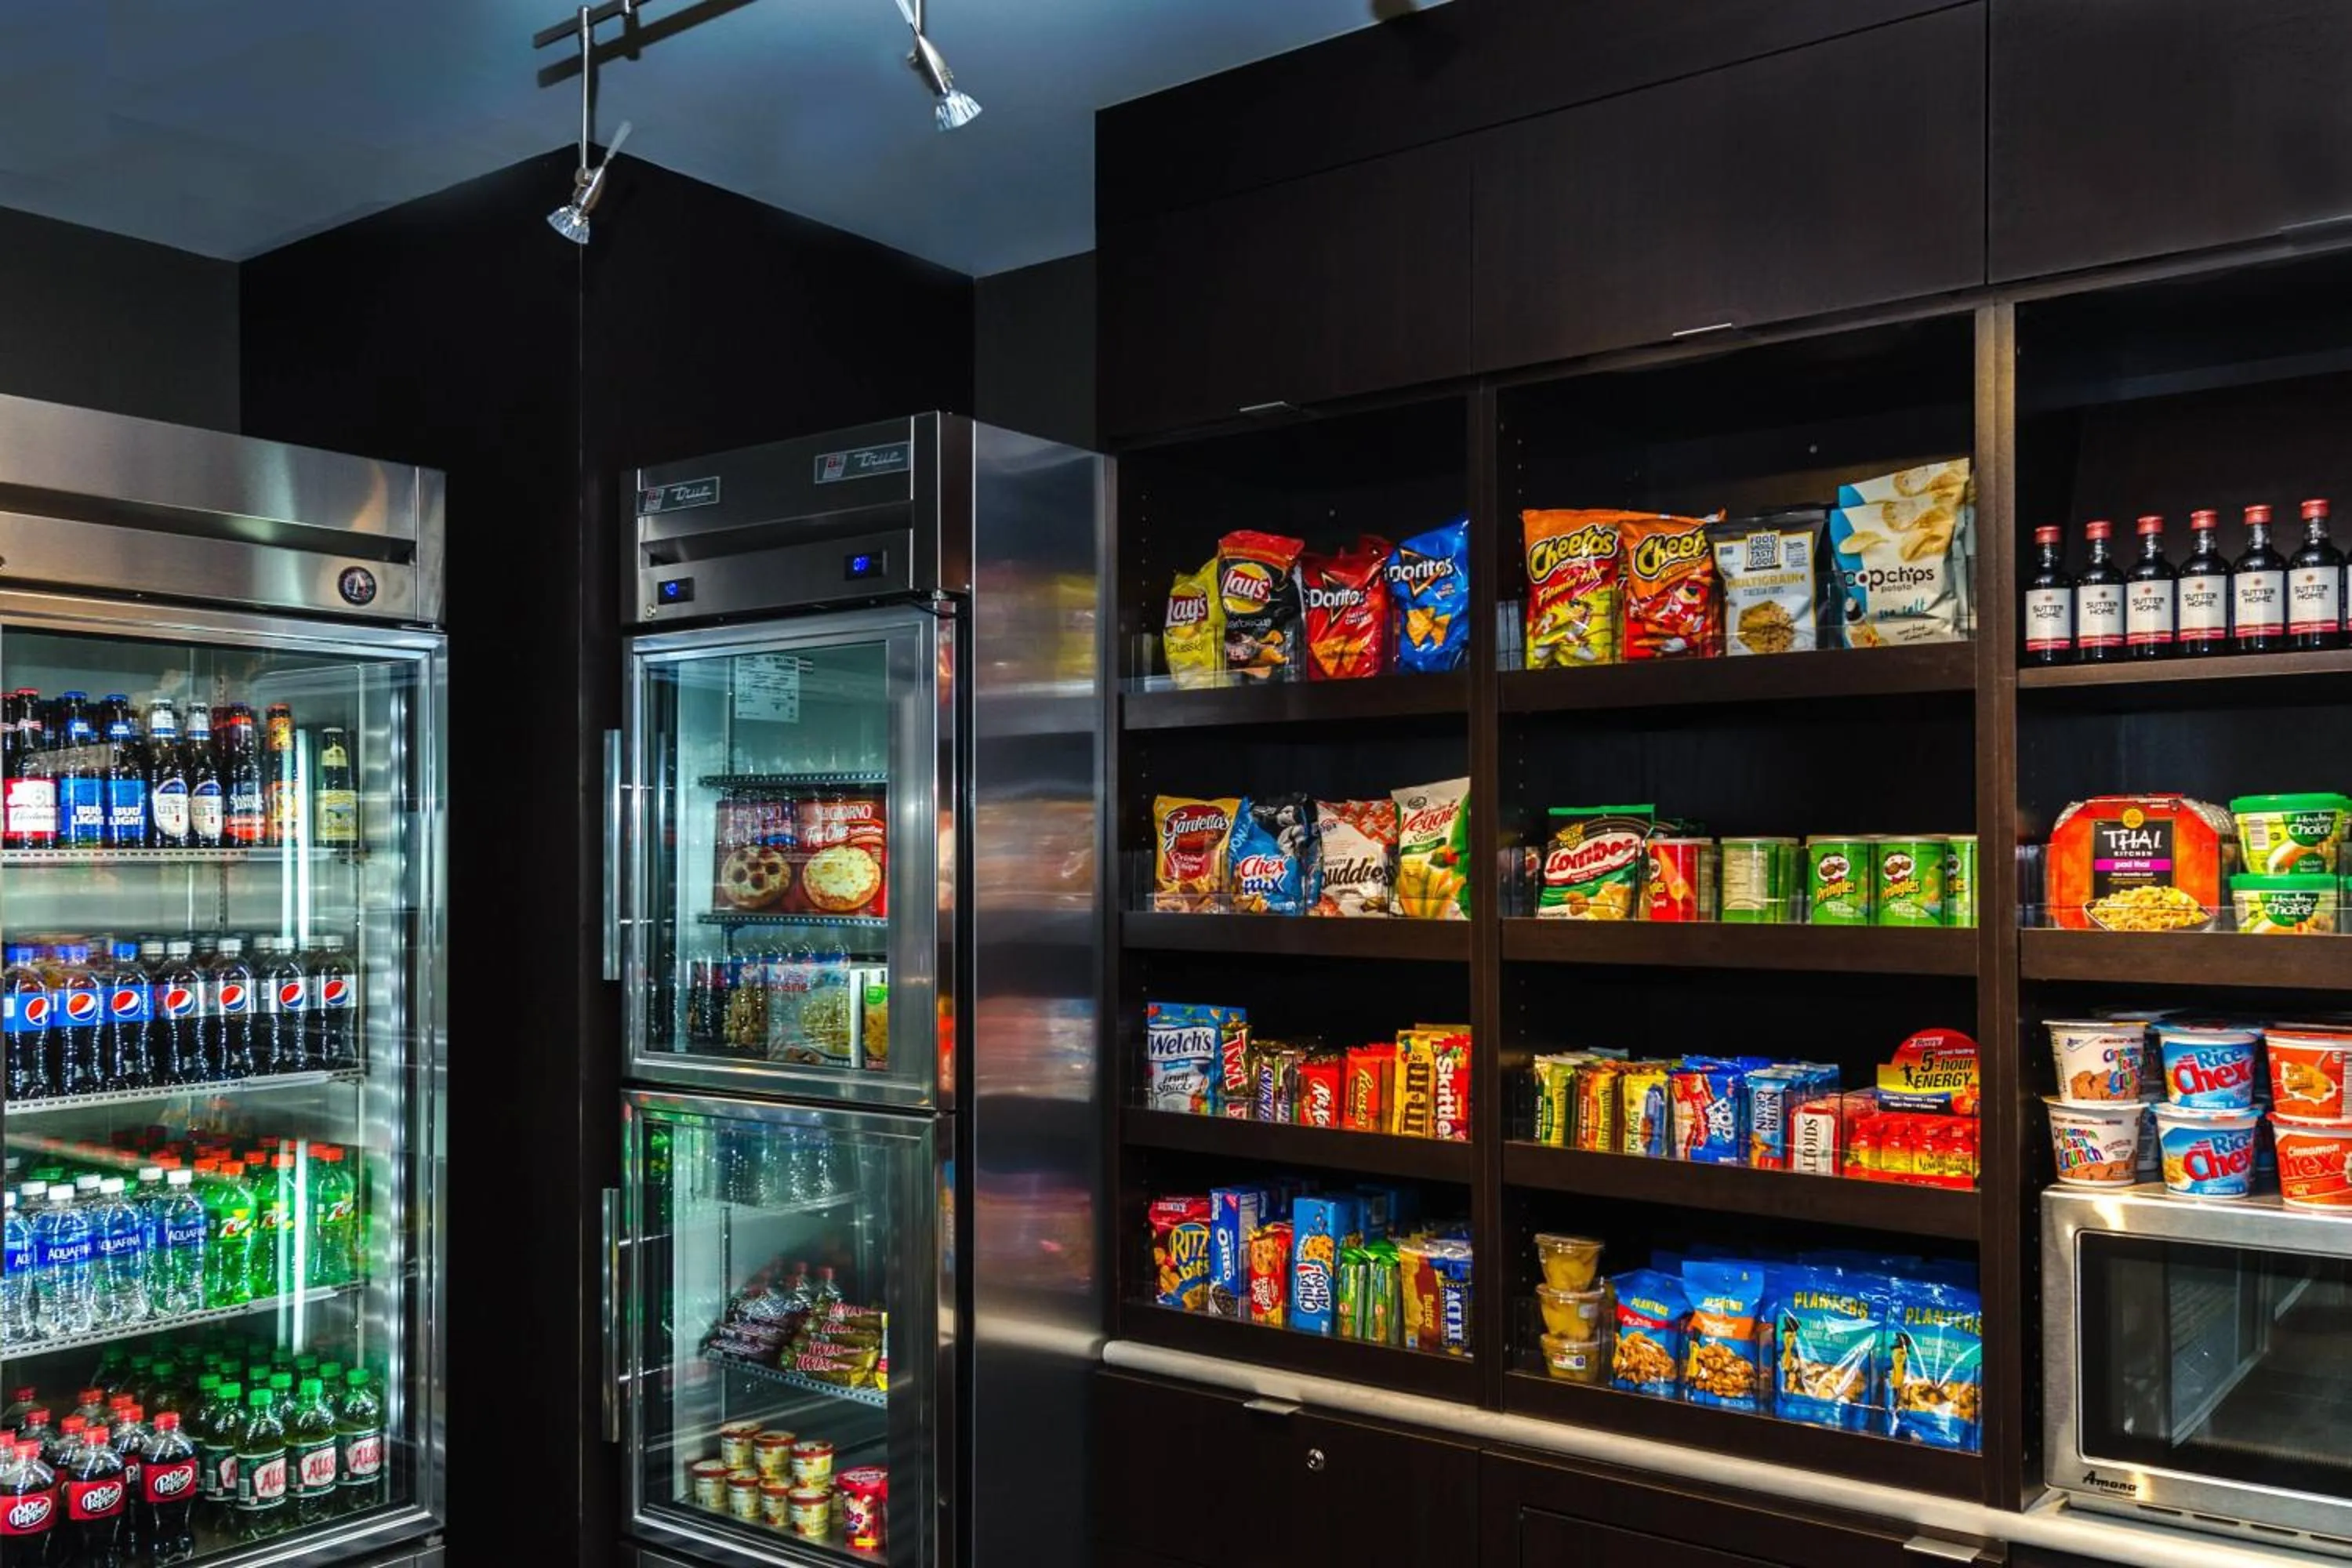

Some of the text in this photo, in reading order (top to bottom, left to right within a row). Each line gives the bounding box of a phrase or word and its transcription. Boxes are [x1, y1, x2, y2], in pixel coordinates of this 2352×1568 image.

[854, 451, 902, 467] True
[670, 486, 712, 501] True
[1530, 525, 1617, 580] Cheetos
[1635, 528, 1707, 578] Cheet
[1388, 557, 1453, 582] Doritos
[1843, 566, 1935, 591] popchips
[1221, 569, 1272, 601] Lay's
[2241, 588, 2276, 597] SUTTER
[2294, 584, 2328, 593] SUTTER
[2132, 597, 2165, 606] SUTTER
[2184, 592, 2217, 601] SUTTER
[2297, 592, 2325, 601] HOME
[1165, 593, 1208, 627] Lay's
[2032, 604, 2063, 613] SUTTER
[76, 806, 103, 816] BUD
[109, 815, 146, 826] LIGHT
[112, 807, 142, 816] BUD
[158, 804, 187, 815] ULT
[193, 807, 220, 818] ULT
[2102, 829, 2161, 851] THAI
[1241, 855, 1288, 877] Chex
[1817, 878, 1856, 902] Pringles
[1882, 878, 1921, 898] Pringles
[2265, 902, 2312, 916] Choice
[1149, 1030, 1211, 1055] Welch's
[1221, 1029, 1248, 1091] TWI
[1920, 1048, 1973, 1073] 5-hour
[2196, 1048, 2242, 1069] Rice
[1913, 1072, 1973, 1089] ENERGY
[2172, 1059, 2250, 1095] Chex
[1259, 1067, 1273, 1122] SNICKE
[1755, 1091, 1766, 1131] GRAIN
[1767, 1092, 1778, 1131] NUTRI
[1804, 1118, 1819, 1172] LTOIDS
[2212, 1133, 2252, 1154] Ric
[2287, 1144, 2339, 1156] Cinnamon
[2059, 1145, 2103, 1170] Crunch
[2281, 1153, 2339, 1176] hex
[1171, 1229, 1210, 1264] RITZ
[1218, 1228, 1232, 1281] OREO
[1298, 1273, 1318, 1312] Chips
[1446, 1289, 1461, 1319] ACT
[1794, 1291, 1868, 1321] PLANTERS
[97, 1486, 113, 1498] Dr
[159, 1472, 191, 1494] Pepper
[2082, 1470, 2137, 1492] Amana
[25, 1501, 41, 1512] Dr
[86, 1488, 120, 1511] Pepper
[14, 1503, 49, 1526] Pepper
